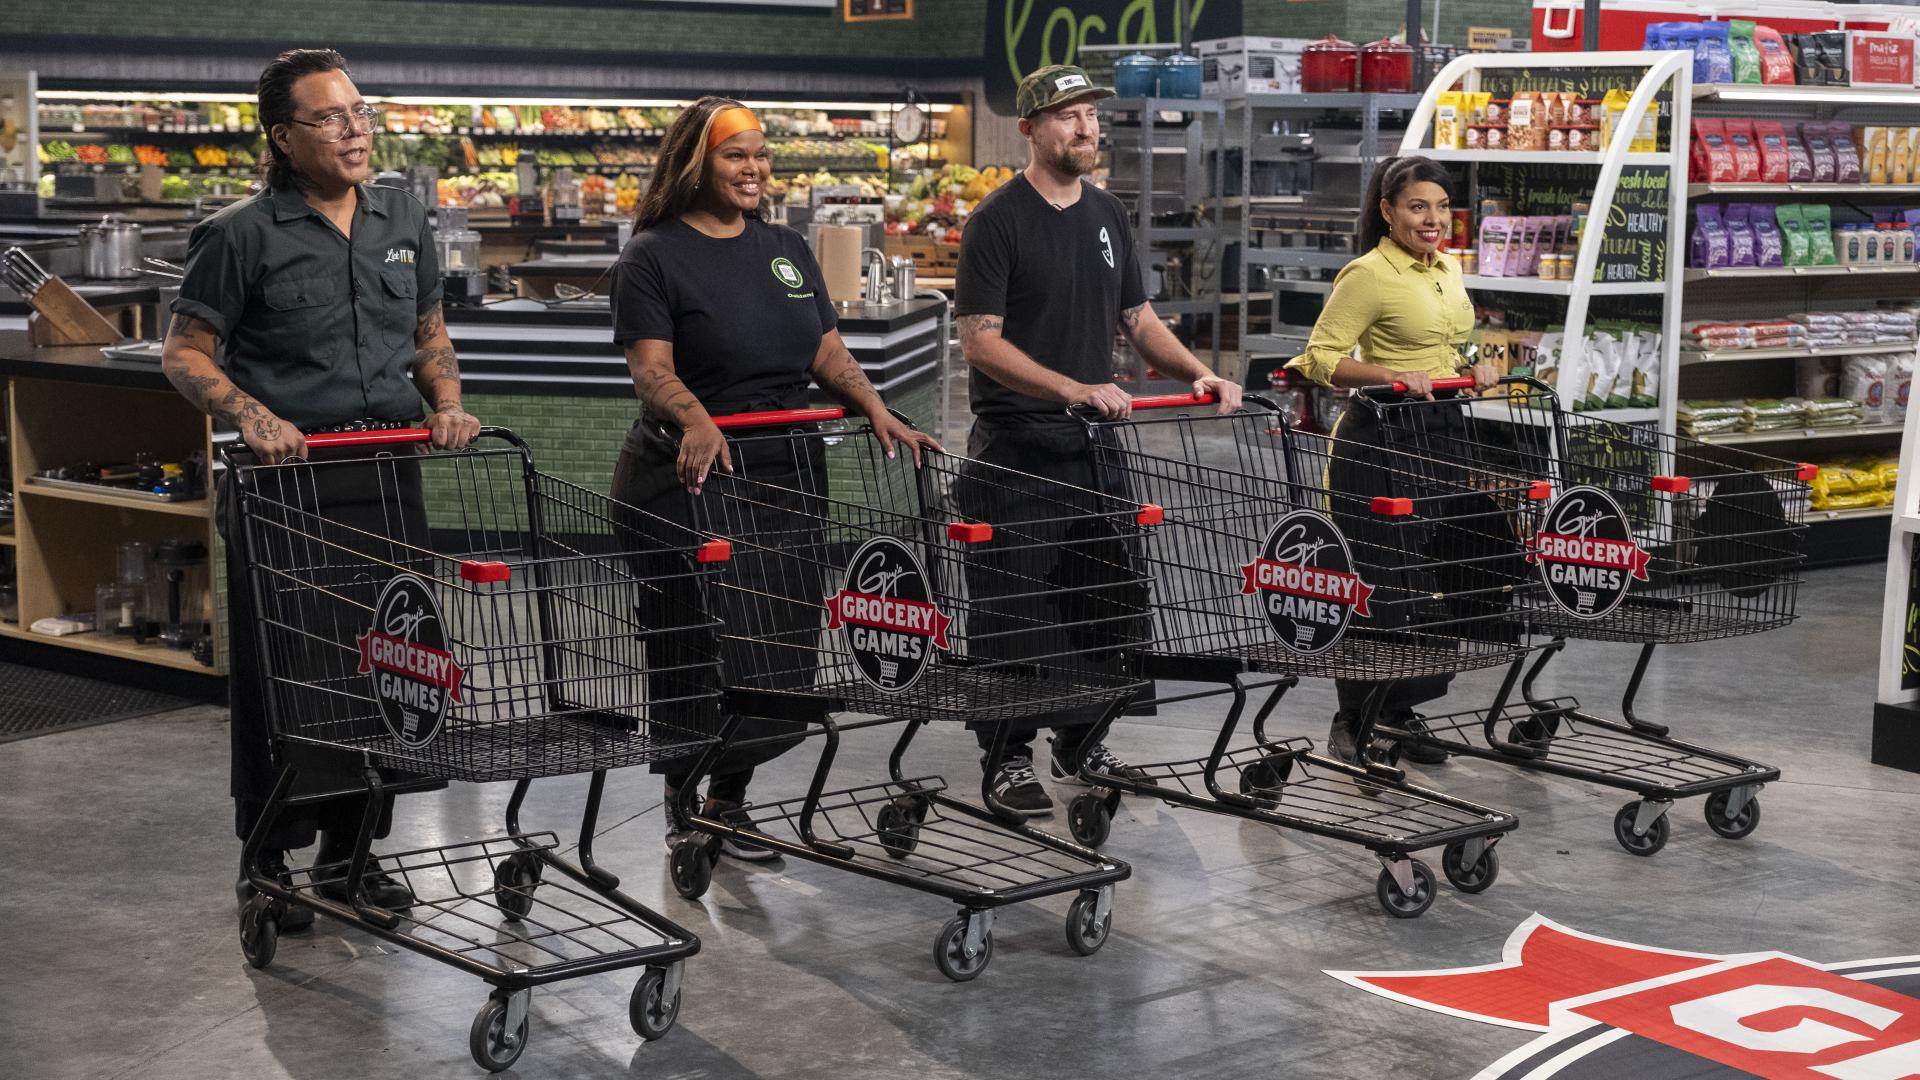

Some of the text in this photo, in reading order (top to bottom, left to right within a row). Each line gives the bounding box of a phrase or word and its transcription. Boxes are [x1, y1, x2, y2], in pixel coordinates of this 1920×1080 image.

[1643, 169, 1669, 189] local
[1627, 212, 1665, 233] HEALTHY
[1607, 263, 1639, 281] HEALTHY
[1636, 239, 1652, 278] local
[1556, 499, 1617, 542] Guy's
[1275, 524, 1339, 573] Guy's
[1540, 537, 1634, 565] GROCERY
[858, 551, 917, 604] Guy's
[1258, 563, 1356, 599] GROCERY
[1550, 563, 1621, 590] GAMES
[384, 590, 436, 647] Guy's
[842, 595, 934, 631] GROCERY
[1268, 593, 1341, 625] GAMES
[371, 636, 450, 682] GROCERY
[853, 627, 922, 660] GAMES
[380, 672, 440, 714] GAMES
